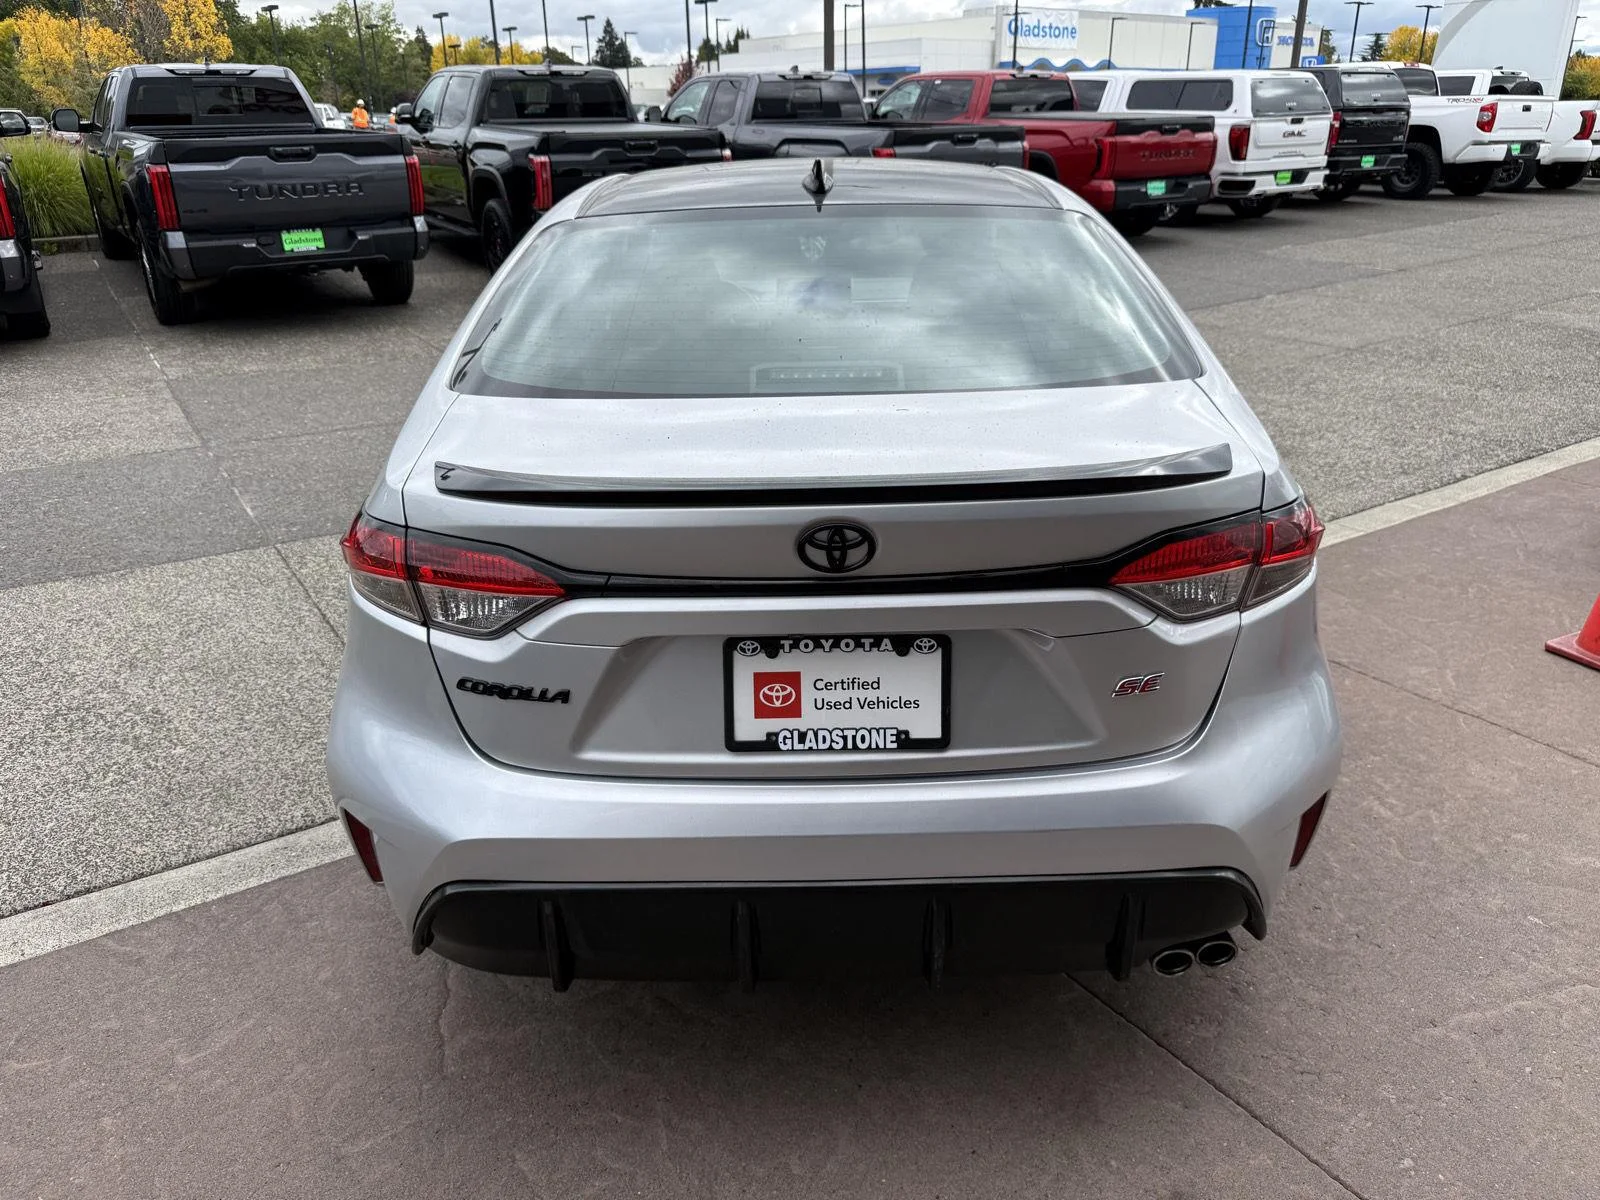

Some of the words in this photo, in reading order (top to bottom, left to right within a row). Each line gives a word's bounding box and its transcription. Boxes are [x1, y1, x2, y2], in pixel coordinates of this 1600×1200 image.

[1008, 17, 1077, 39] Gladstone
[1277, 35, 1315, 47] HODA
[1282, 130, 1307, 138] GMC
[229, 183, 364, 201] TUNDRA
[284, 236, 322, 245] Gladstone
[780, 638, 894, 653] TOYOTA
[456, 677, 570, 704] COROLLA
[813, 677, 881, 691] Certified
[1111, 672, 1165, 698] SE
[814, 697, 853, 711] Used
[857, 696, 920, 710] Vehicles
[777, 728, 898, 750] GLADSTONE
